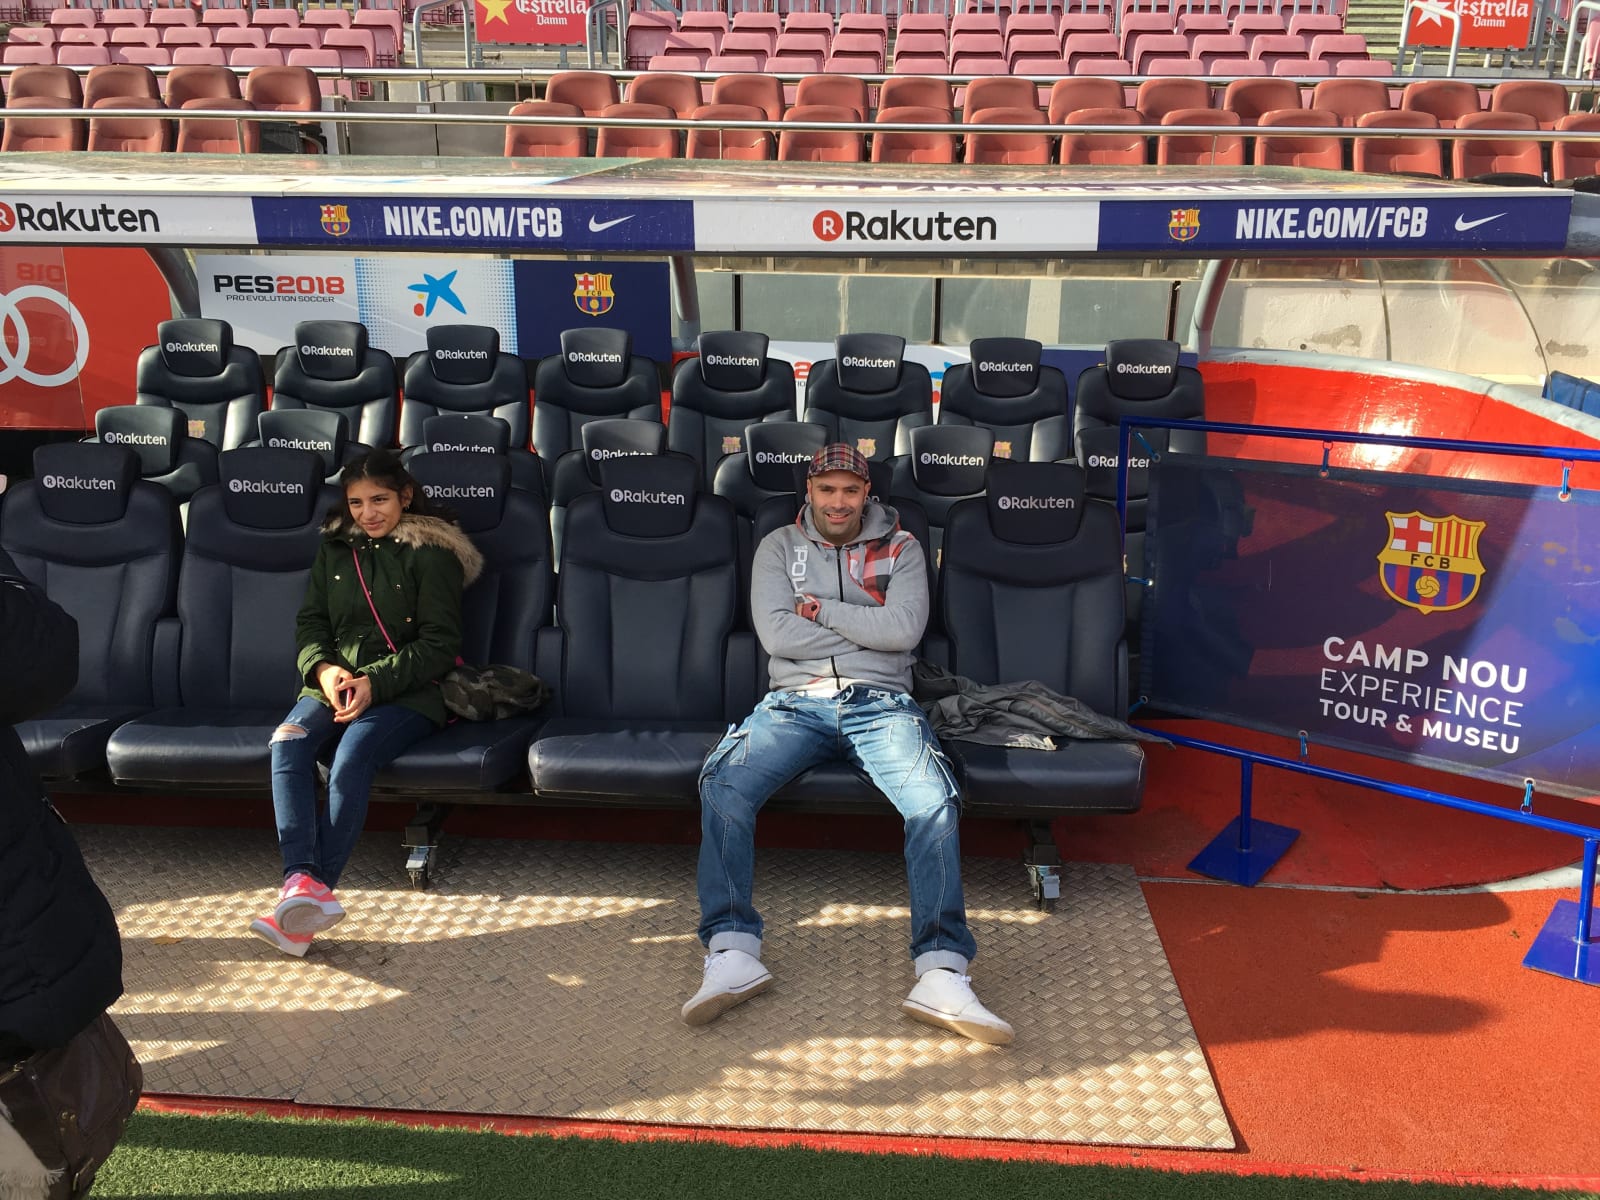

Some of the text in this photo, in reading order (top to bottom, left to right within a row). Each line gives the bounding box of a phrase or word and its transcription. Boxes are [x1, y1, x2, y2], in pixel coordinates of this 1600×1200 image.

[536, 14, 568, 26] Damm
[1472, 15, 1506, 28] Damm
[15, 203, 160, 235] Rakuten
[383, 206, 563, 239] NIKE.COM/FCB
[846, 209, 998, 241] Rakuten
[1235, 206, 1429, 240] NIKE.COM/FCB
[226, 294, 336, 303] PRO EVOLUTION SOCCER
[176, 342, 219, 353] Rakuten
[311, 345, 354, 358] Rakuten
[445, 349, 488, 361] Rakuten
[578, 351, 622, 363] Rakuten
[716, 354, 760, 367] Rakuten
[852, 355, 896, 369] Rakuten
[988, 361, 1033, 373] Rakuten
[1126, 363, 1172, 375] Rakuten
[115, 432, 168, 446] Rakuten
[280, 438, 332, 451] Rakuten
[931, 453, 985, 467] Rakuten
[56, 476, 117, 492] Rakuten
[243, 479, 304, 495] Rakuten
[433, 484, 495, 499] Rakuten
[623, 489, 685, 506] Rakuten
[1011, 495, 1076, 510] Rakuten
[1410, 553, 1451, 570] FCB
[1323, 636, 1528, 694] CAMP NOU
[1320, 667, 1524, 728] EXPERIENCE
[1319, 698, 1520, 754] TOUR & MUSEU
